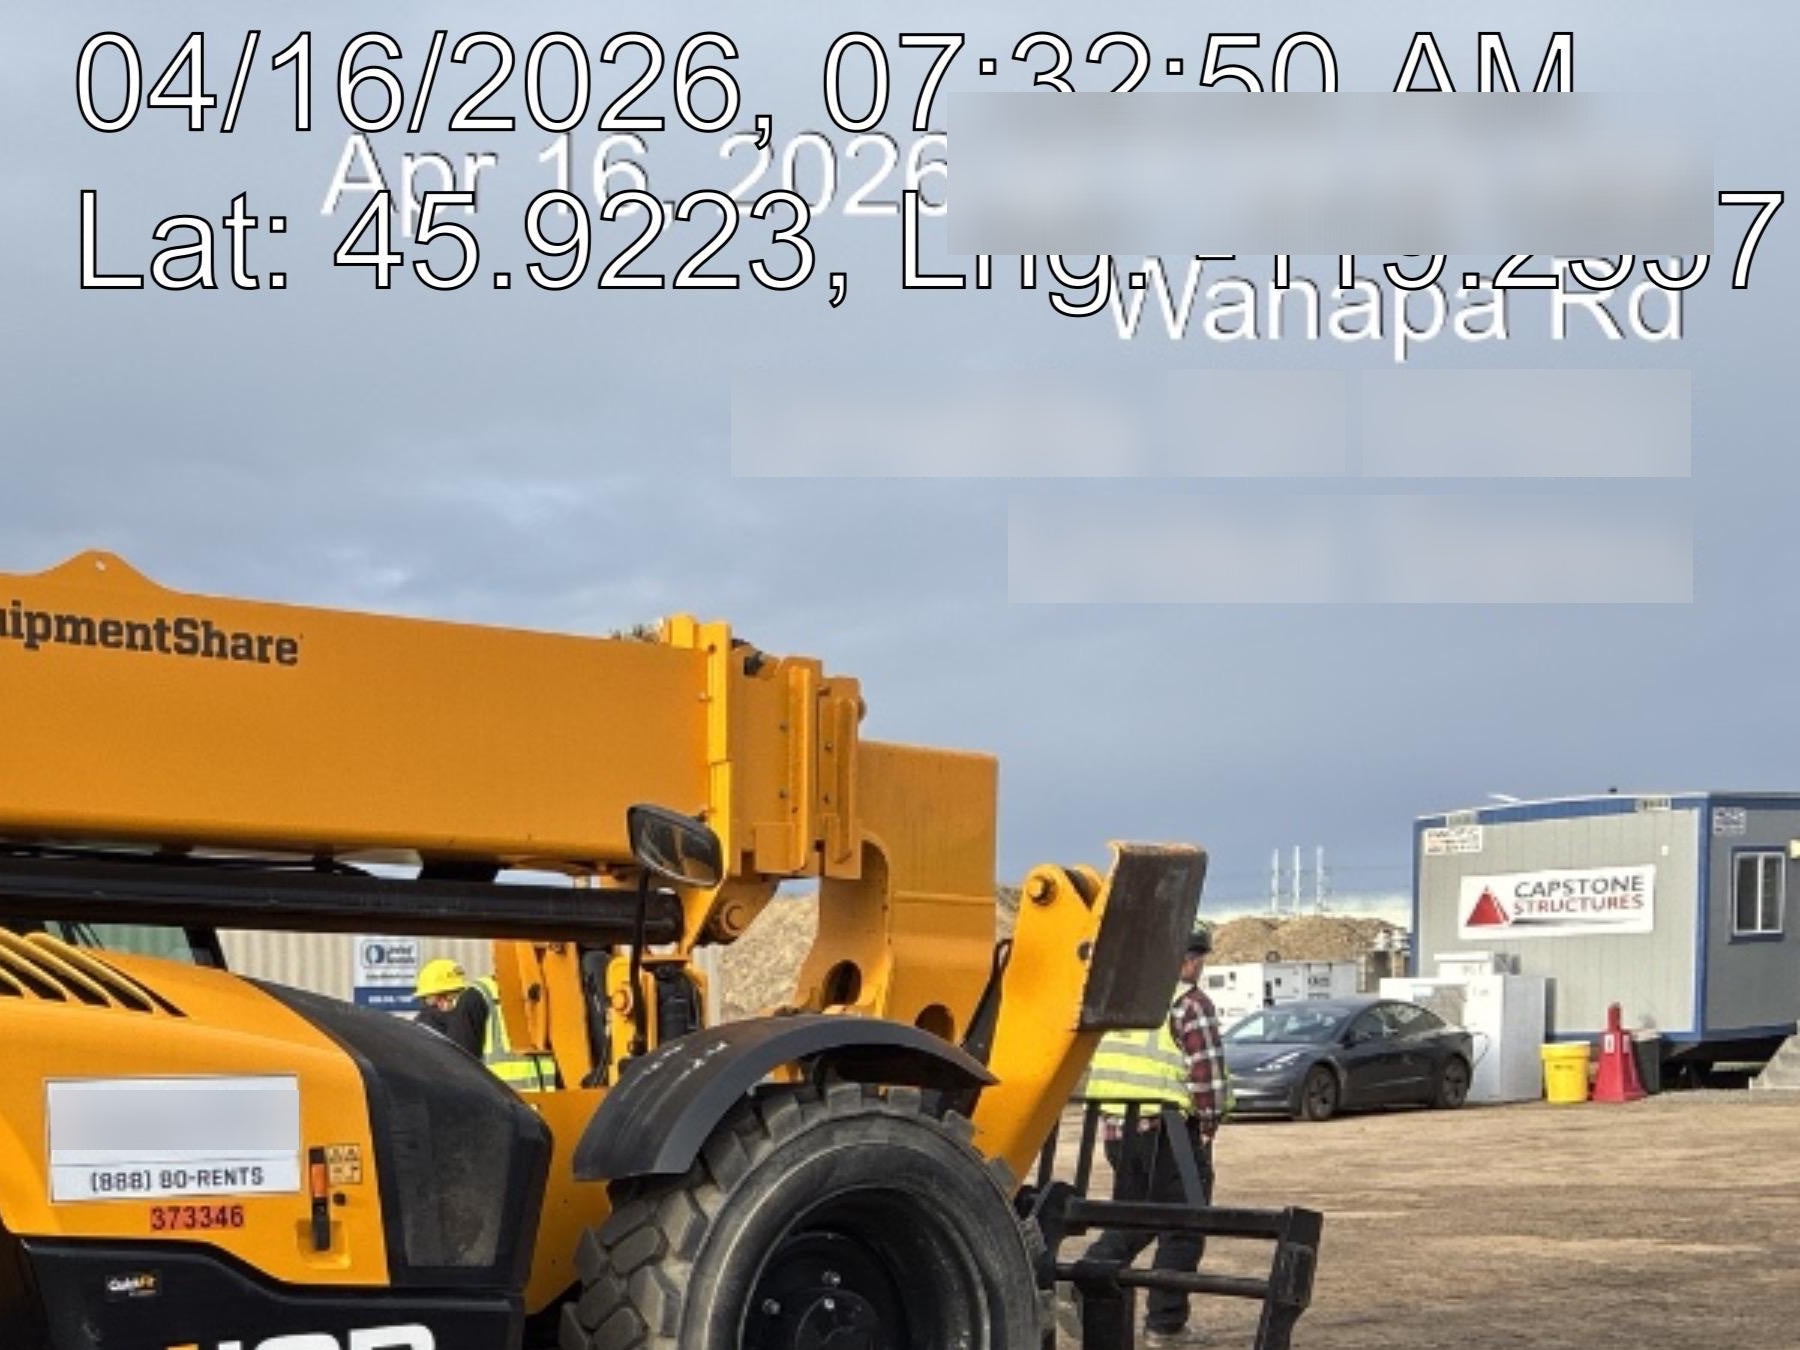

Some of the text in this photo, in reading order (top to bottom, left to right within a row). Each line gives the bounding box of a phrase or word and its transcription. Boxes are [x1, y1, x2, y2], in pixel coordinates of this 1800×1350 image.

[1513, 875, 1645, 898] CAPSTONE
[1513, 893, 1645, 916] STRUCTURES
[90, 1171, 150, 1193] (888)
[151, 1205, 244, 1231] 373346
